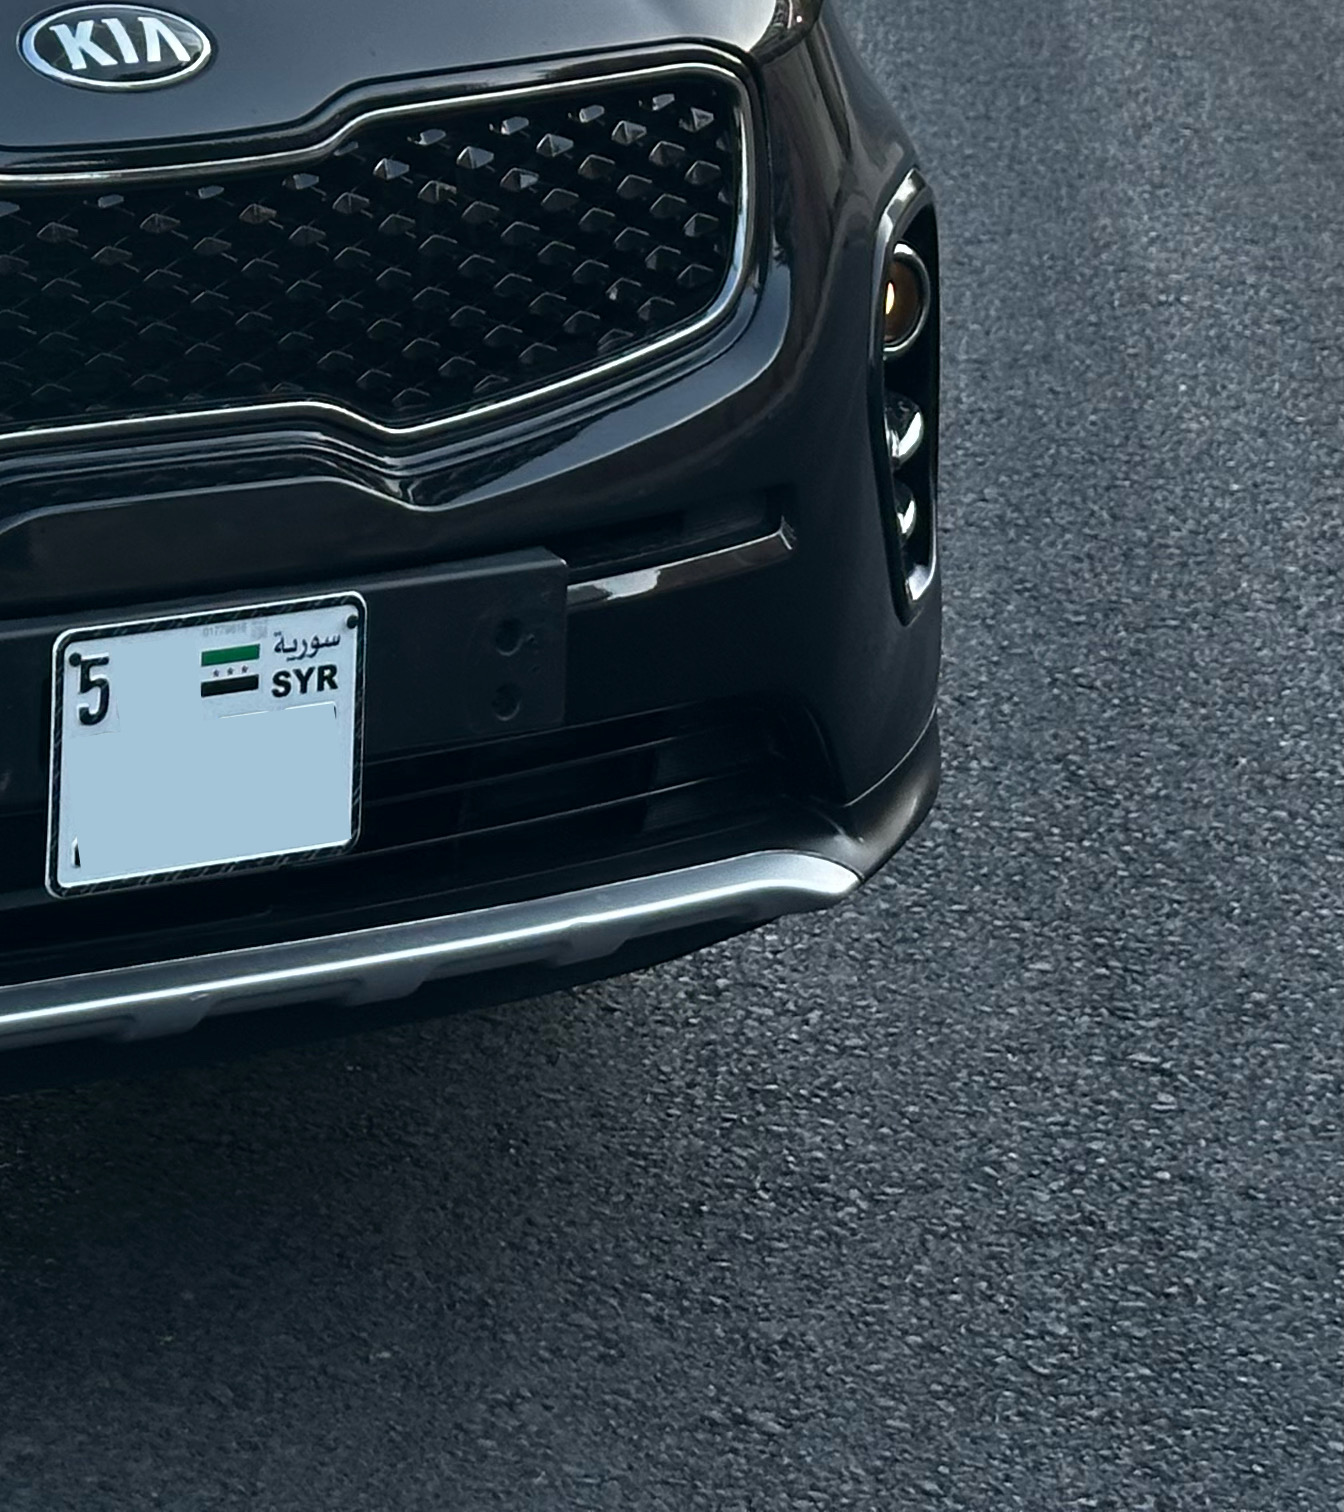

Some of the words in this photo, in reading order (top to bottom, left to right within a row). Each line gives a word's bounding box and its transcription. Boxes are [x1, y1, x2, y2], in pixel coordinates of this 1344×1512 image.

[49, 16, 191, 70] KIA
[273, 631, 341, 662] سورية
[79, 655, 110, 726] 5
[271, 664, 338, 698] SYR
